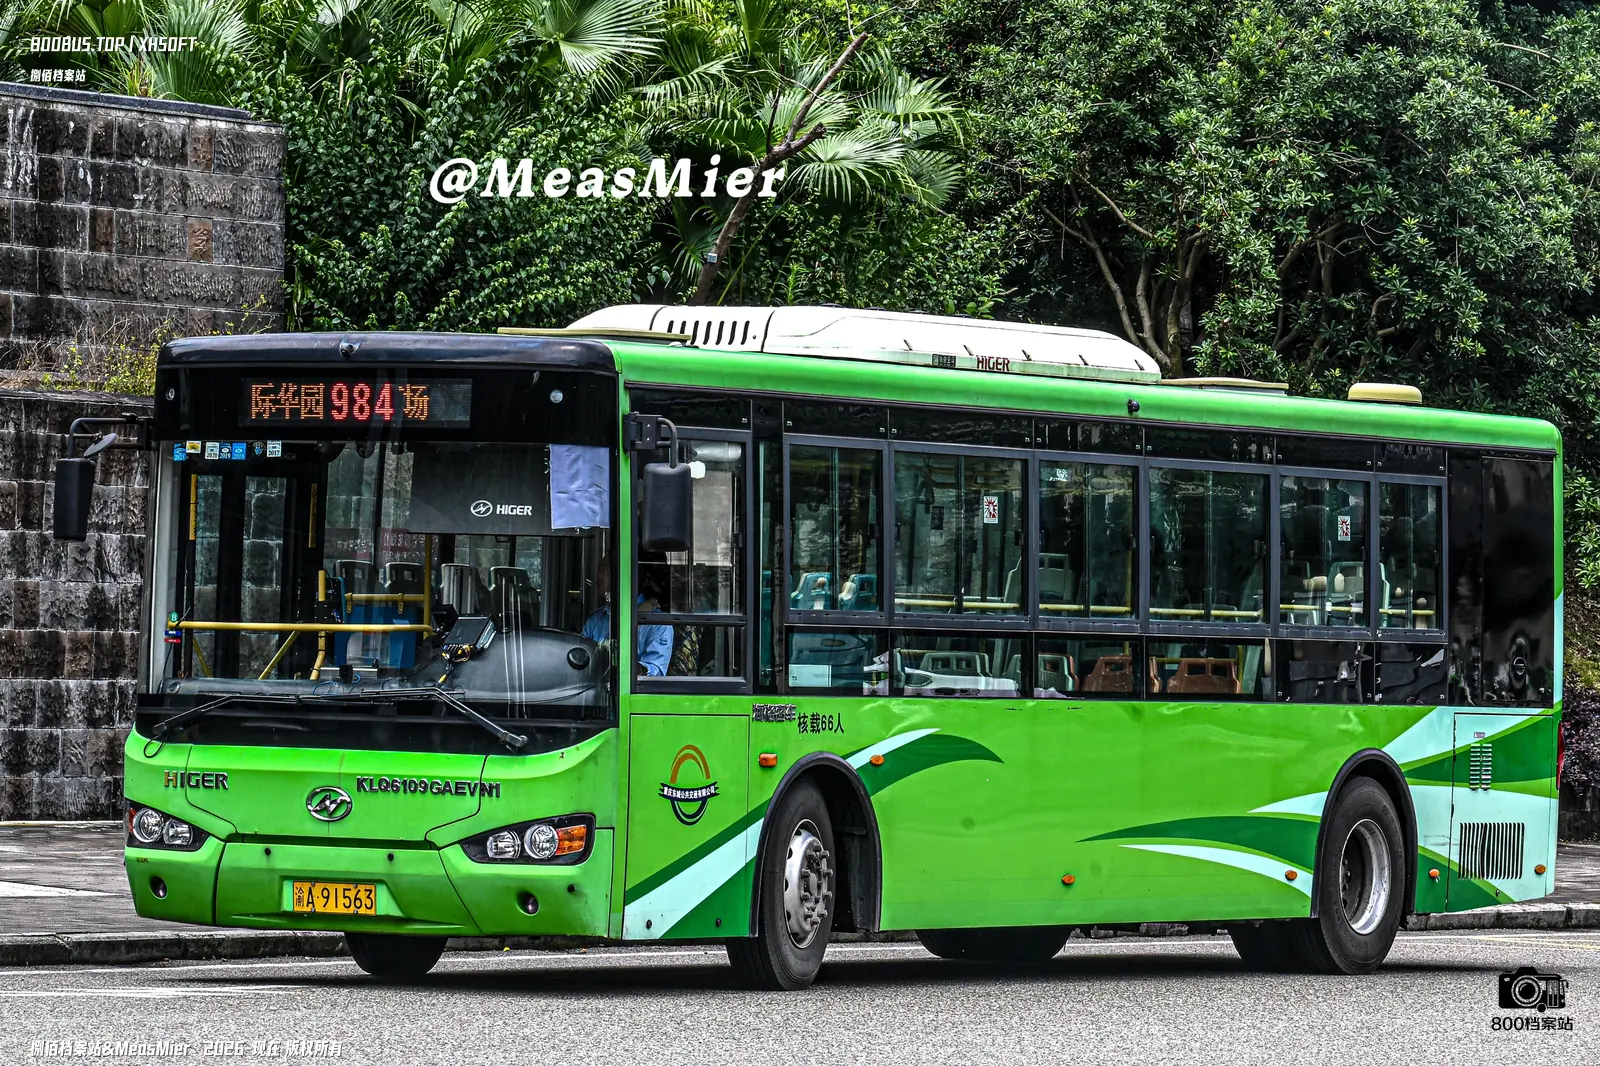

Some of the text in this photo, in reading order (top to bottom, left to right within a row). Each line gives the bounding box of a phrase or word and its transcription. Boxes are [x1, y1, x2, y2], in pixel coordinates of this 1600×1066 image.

[976, 355, 1011, 372] HIGER
[251, 383, 430, 420] 际华园 984 场
[496, 504, 533, 516] HIGER
[797, 712, 845, 734] 核载66人
[164, 770, 229, 789] HIGER
[356, 776, 501, 798] KLQ6109GAEVN1
